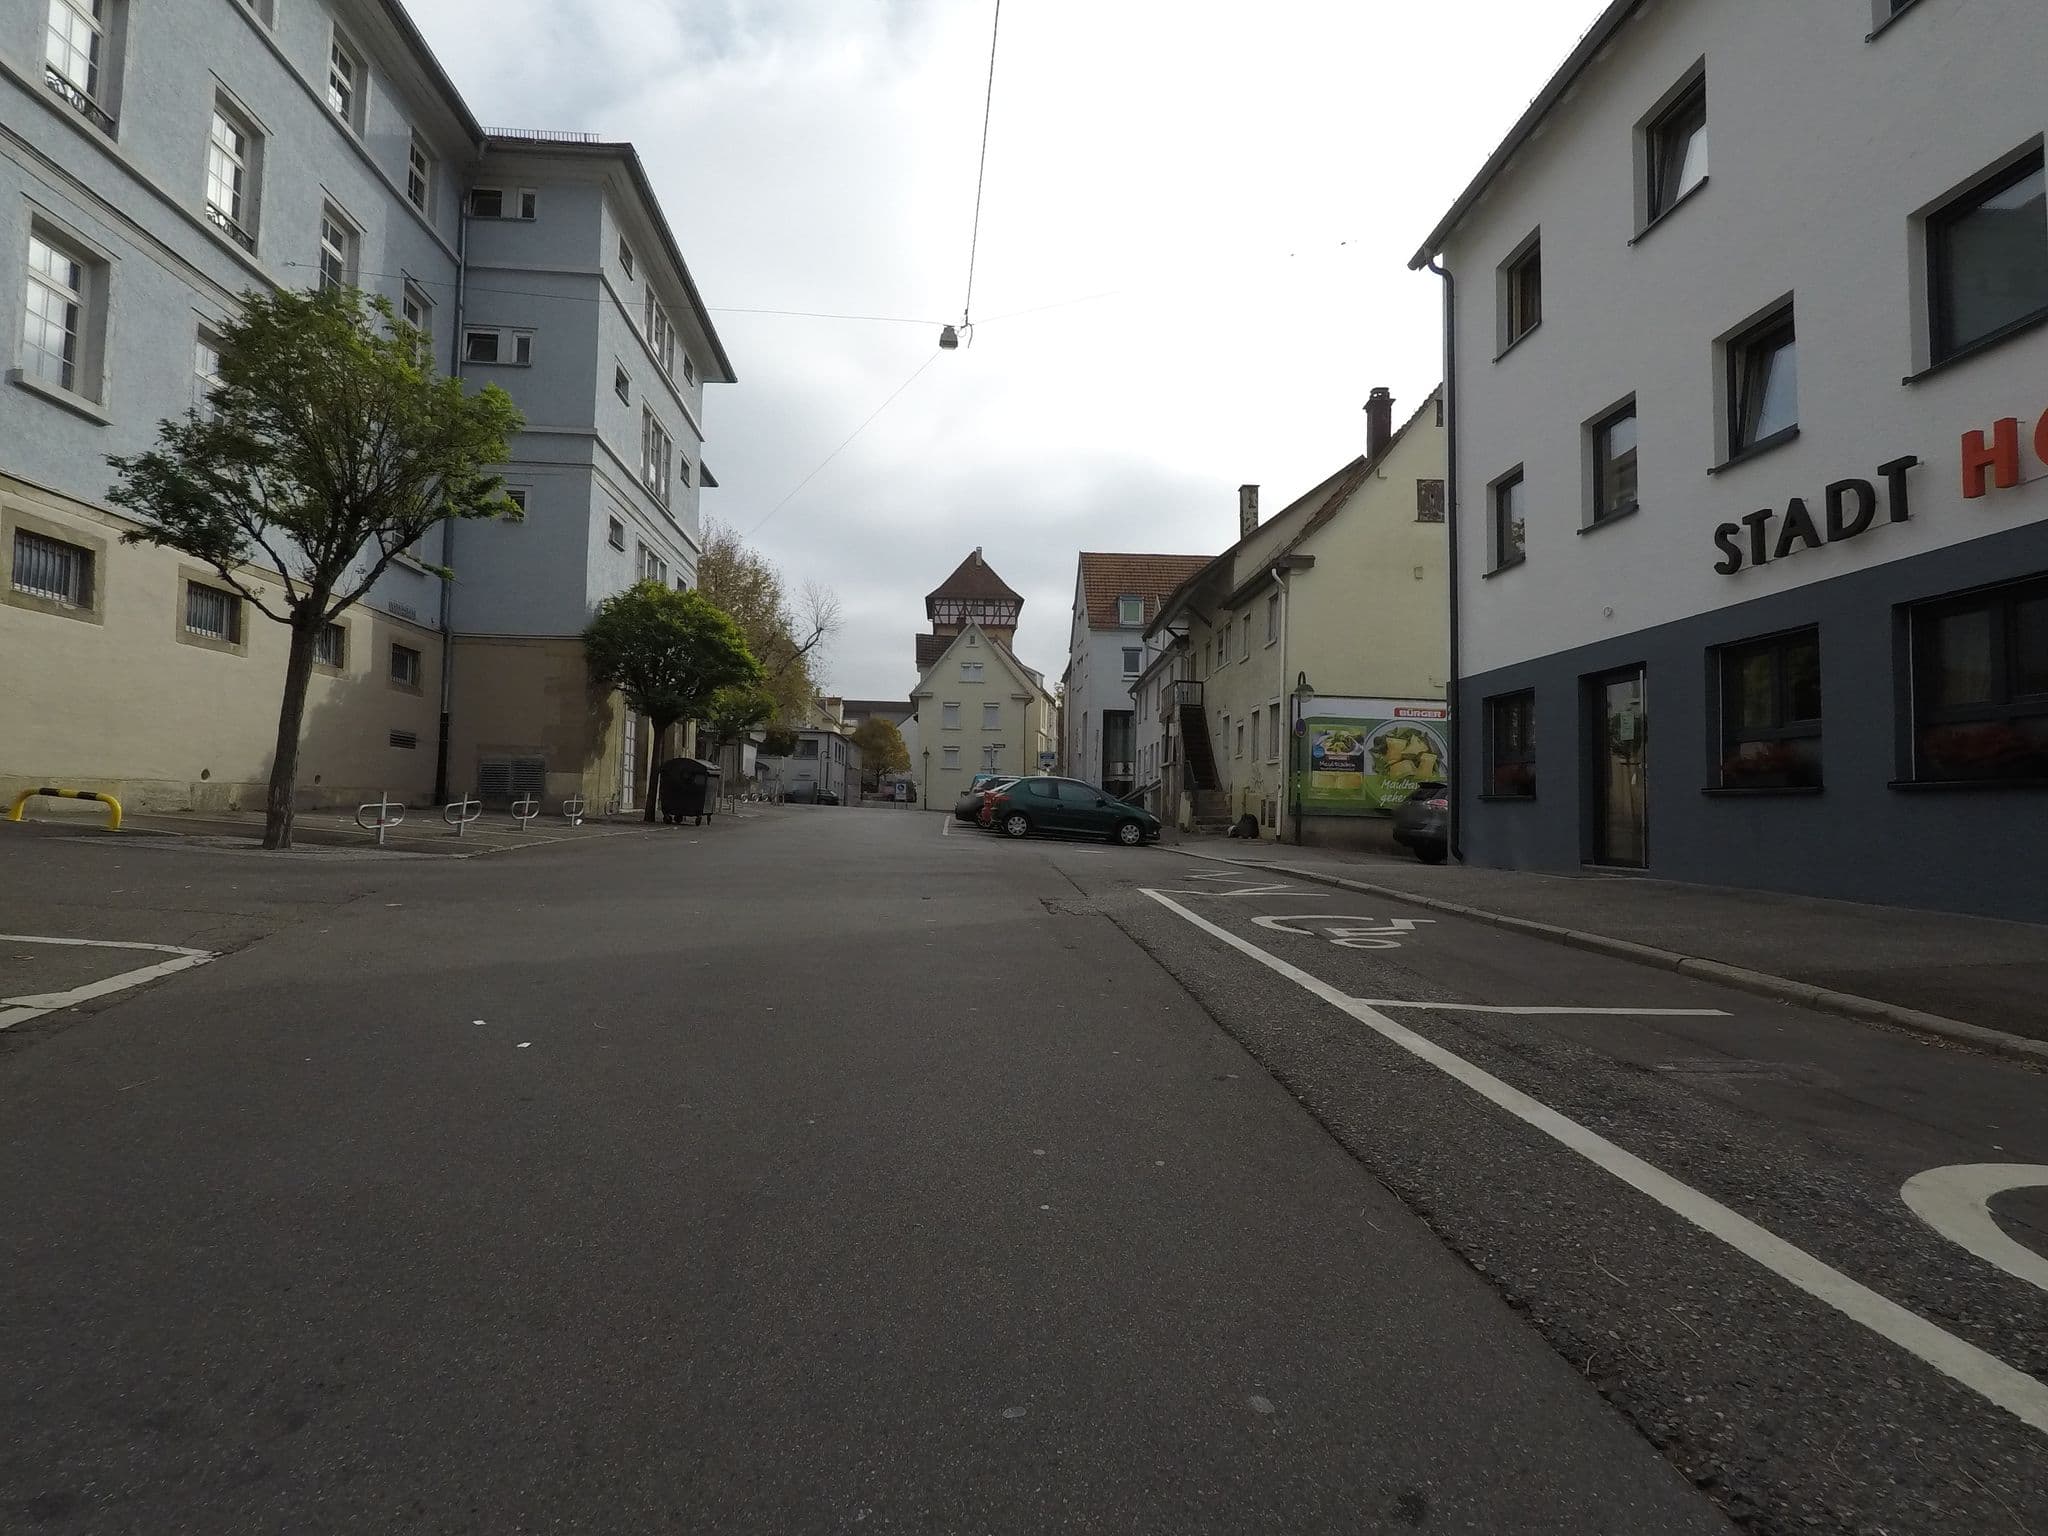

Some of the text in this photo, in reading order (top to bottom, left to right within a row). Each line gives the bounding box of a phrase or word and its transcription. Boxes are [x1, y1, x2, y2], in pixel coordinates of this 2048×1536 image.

[1714, 407, 2048, 575] STADT H
[1399, 708, 1442, 718] BÜRGER
